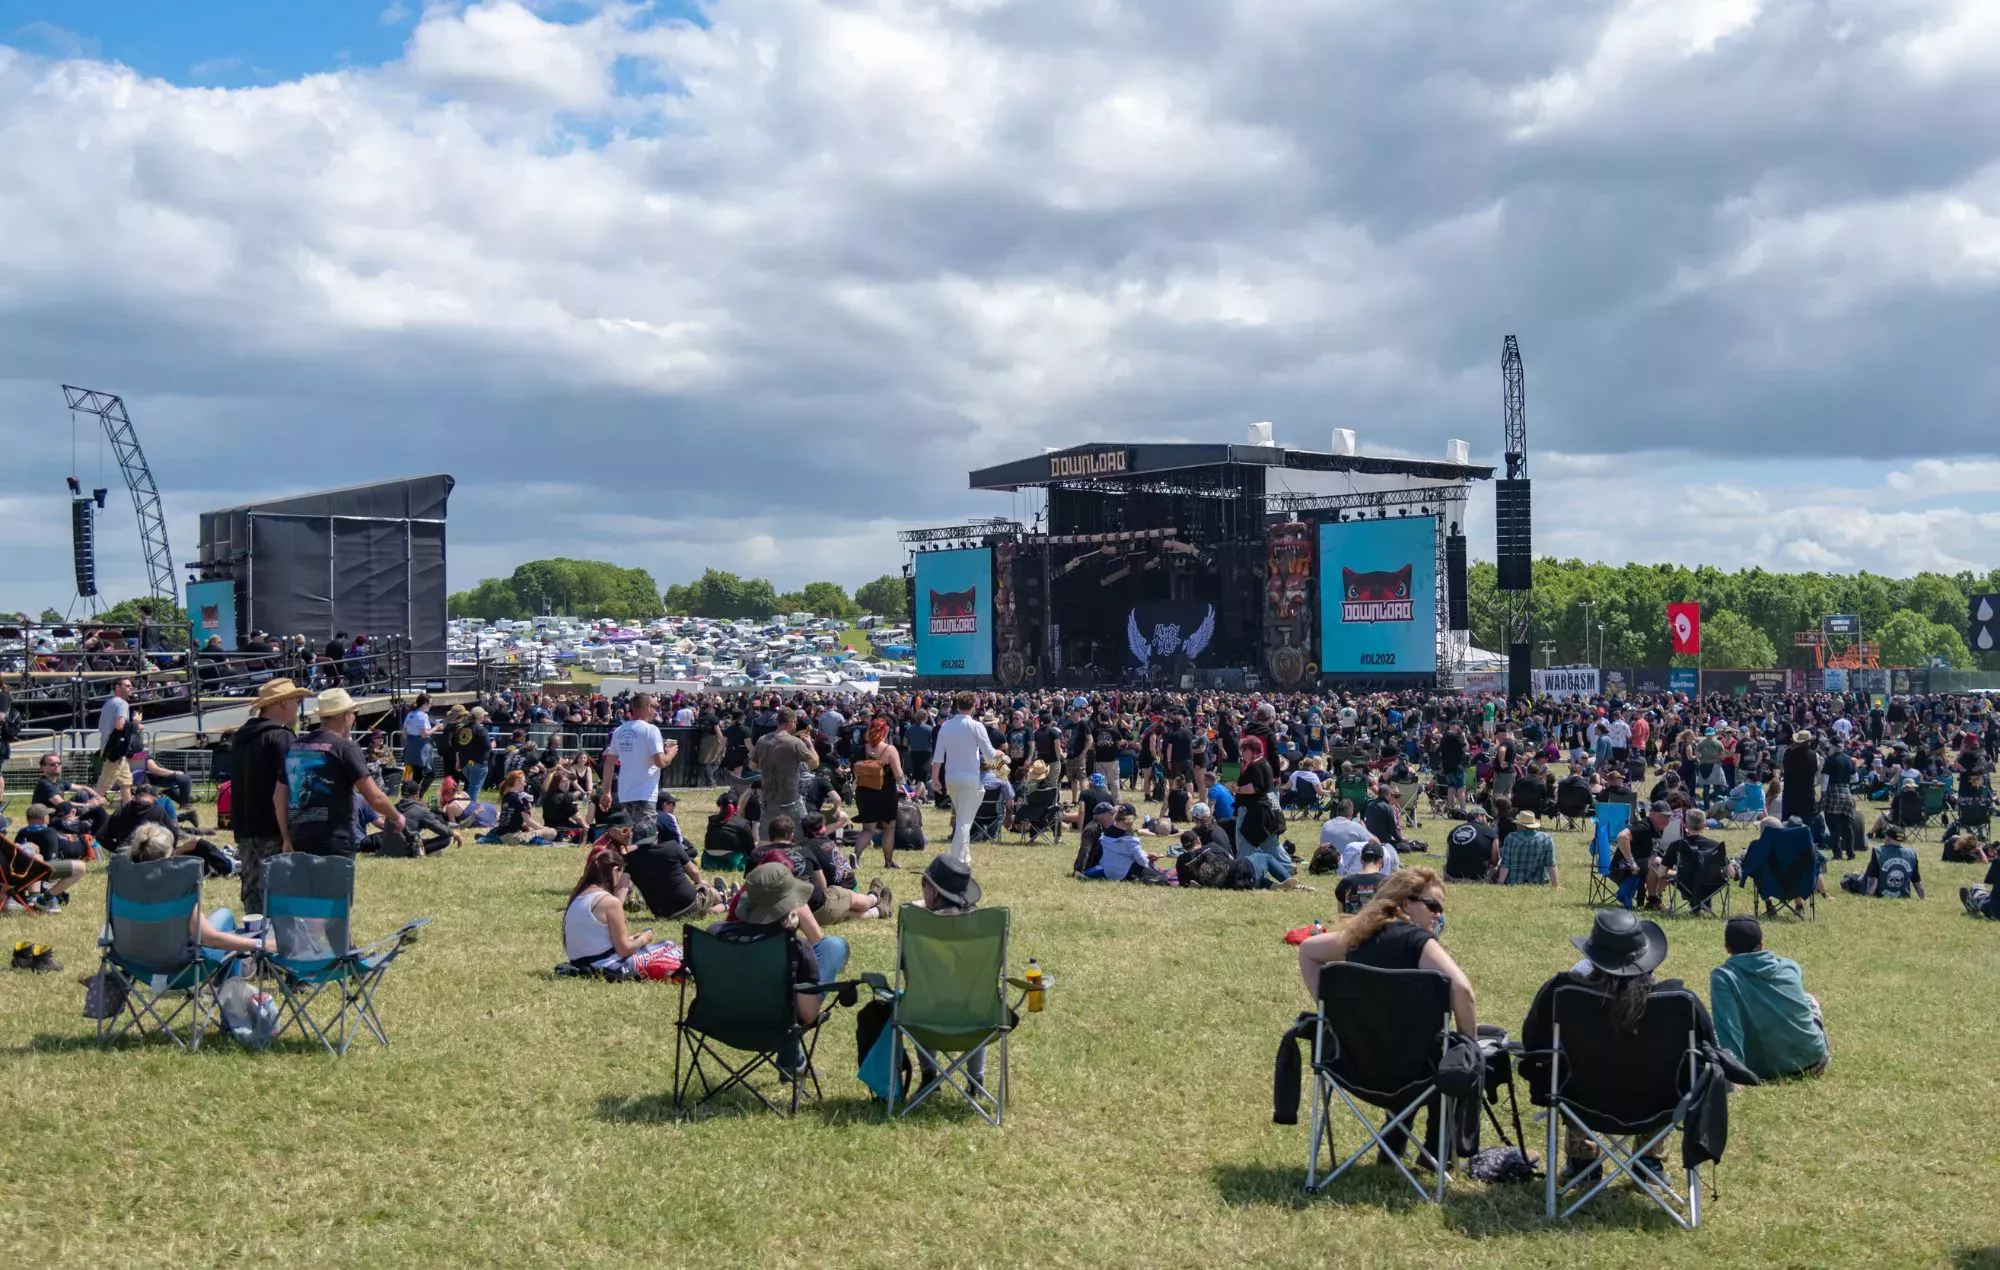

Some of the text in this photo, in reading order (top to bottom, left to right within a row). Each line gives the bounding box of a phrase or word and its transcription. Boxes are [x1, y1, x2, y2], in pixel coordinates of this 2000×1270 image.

[1050, 450, 1126, 477] DOWNLOAD
[1344, 602, 1412, 621] DOWNLOAD
[930, 618, 976, 634] DOWNLOAD
[1360, 653, 1396, 665] #DL2022
[1544, 672, 1596, 690] WARGASM
